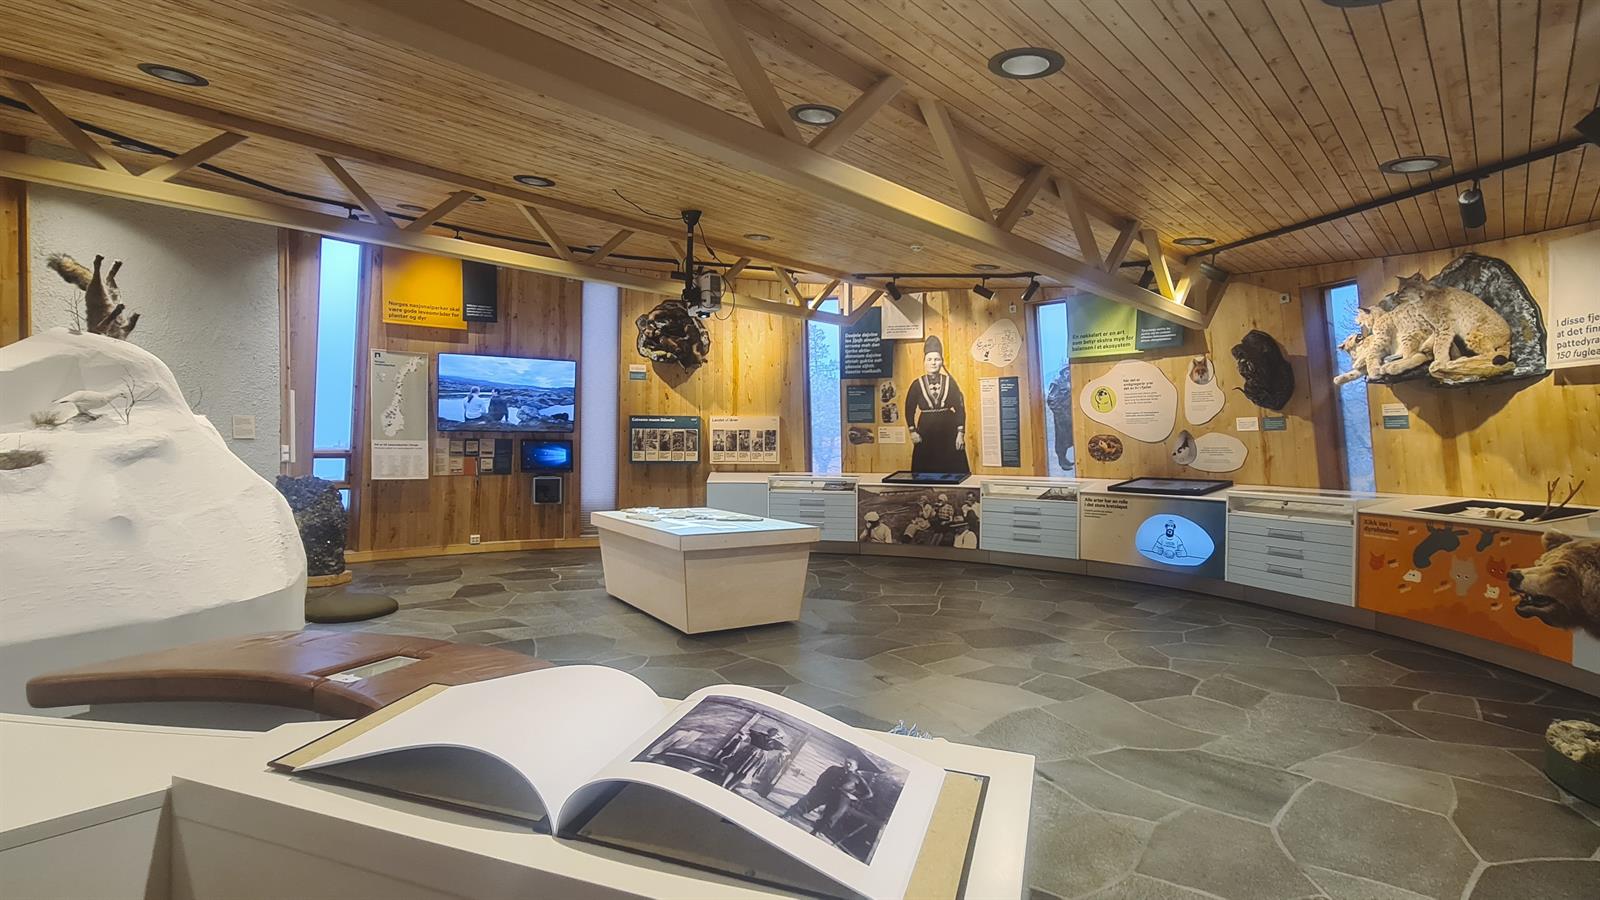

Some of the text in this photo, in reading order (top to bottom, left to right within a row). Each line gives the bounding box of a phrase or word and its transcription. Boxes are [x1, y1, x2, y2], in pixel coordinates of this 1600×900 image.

[1561, 317, 1584, 326] disse
[1556, 324, 1600, 338] at det fin
[1556, 350, 1571, 360] 150
